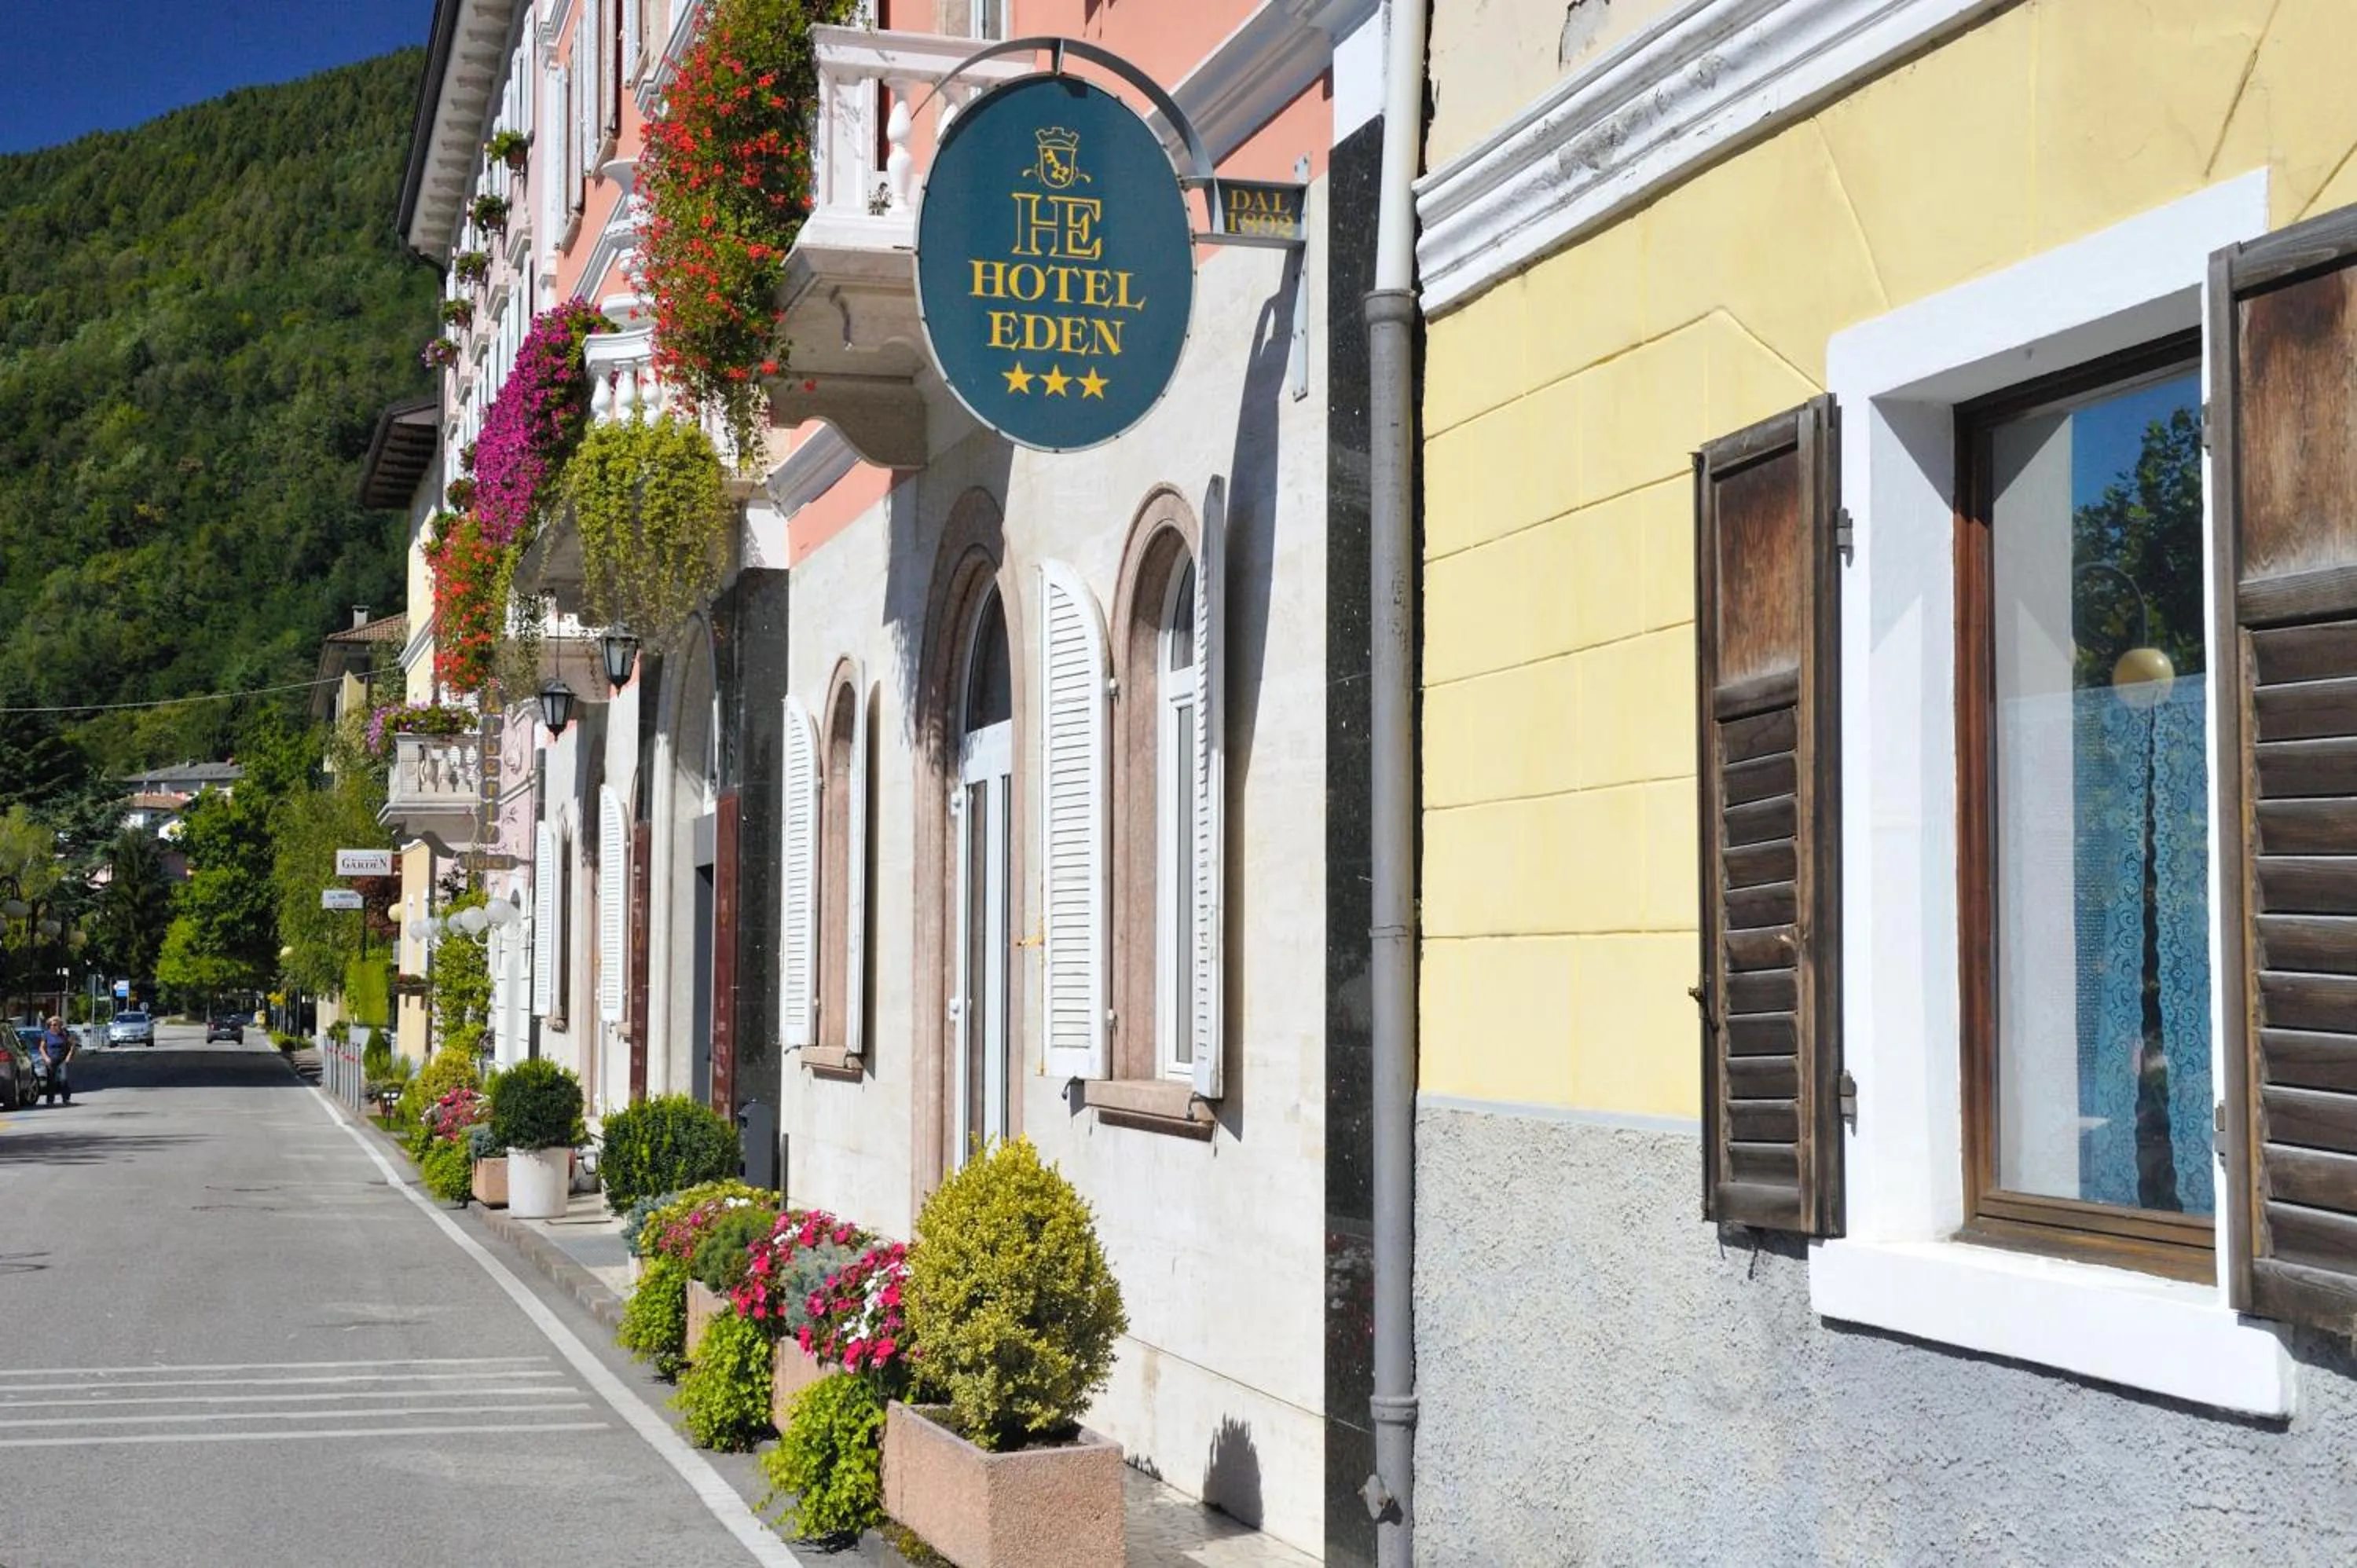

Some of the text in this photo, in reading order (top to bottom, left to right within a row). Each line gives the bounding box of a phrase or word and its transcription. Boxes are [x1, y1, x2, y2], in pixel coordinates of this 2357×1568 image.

[1229, 189, 1292, 214] DAL
[1010, 192, 1102, 262] HE
[967, 258, 1147, 312] HOTEL
[986, 310, 1126, 357] EDEN
